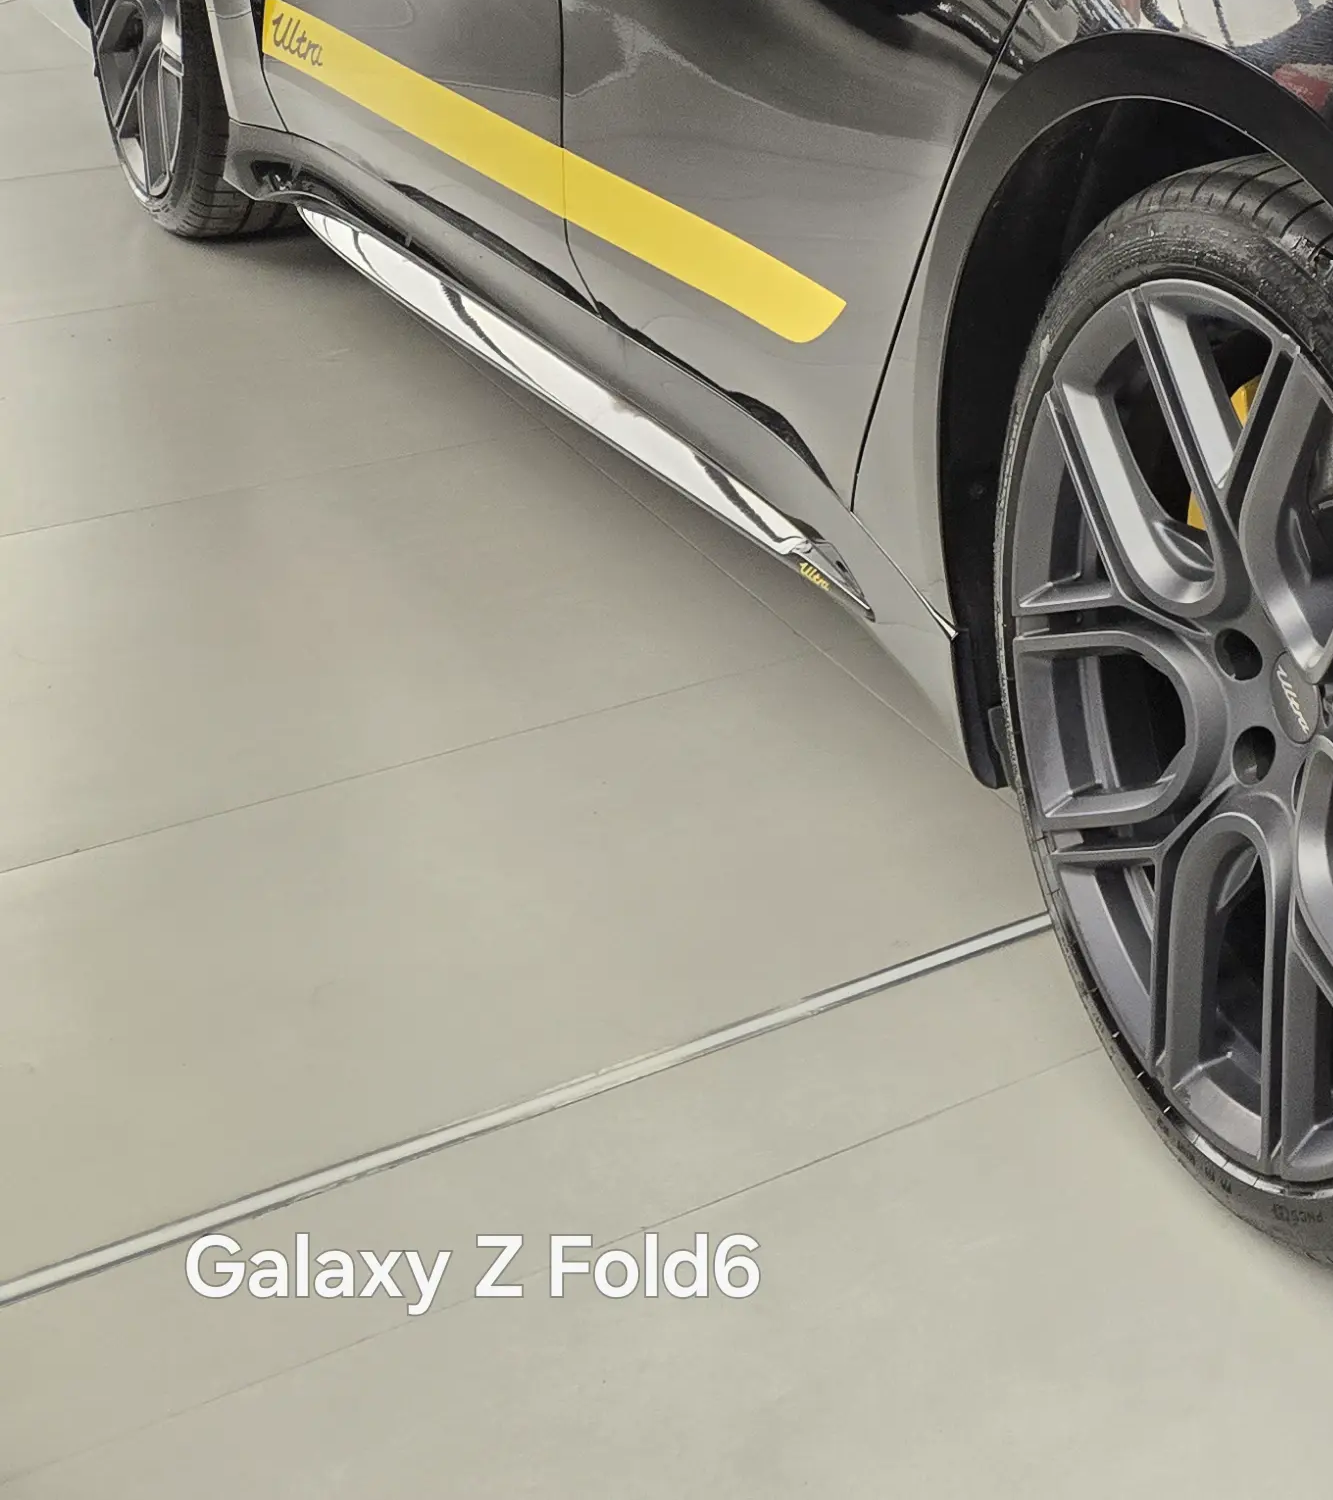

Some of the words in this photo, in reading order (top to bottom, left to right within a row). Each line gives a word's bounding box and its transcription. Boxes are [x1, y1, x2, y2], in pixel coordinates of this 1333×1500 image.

[272, 13, 324, 67] Ultra
[799, 562, 831, 592] Ultra
[1276, 664, 1310, 735] Ultra
